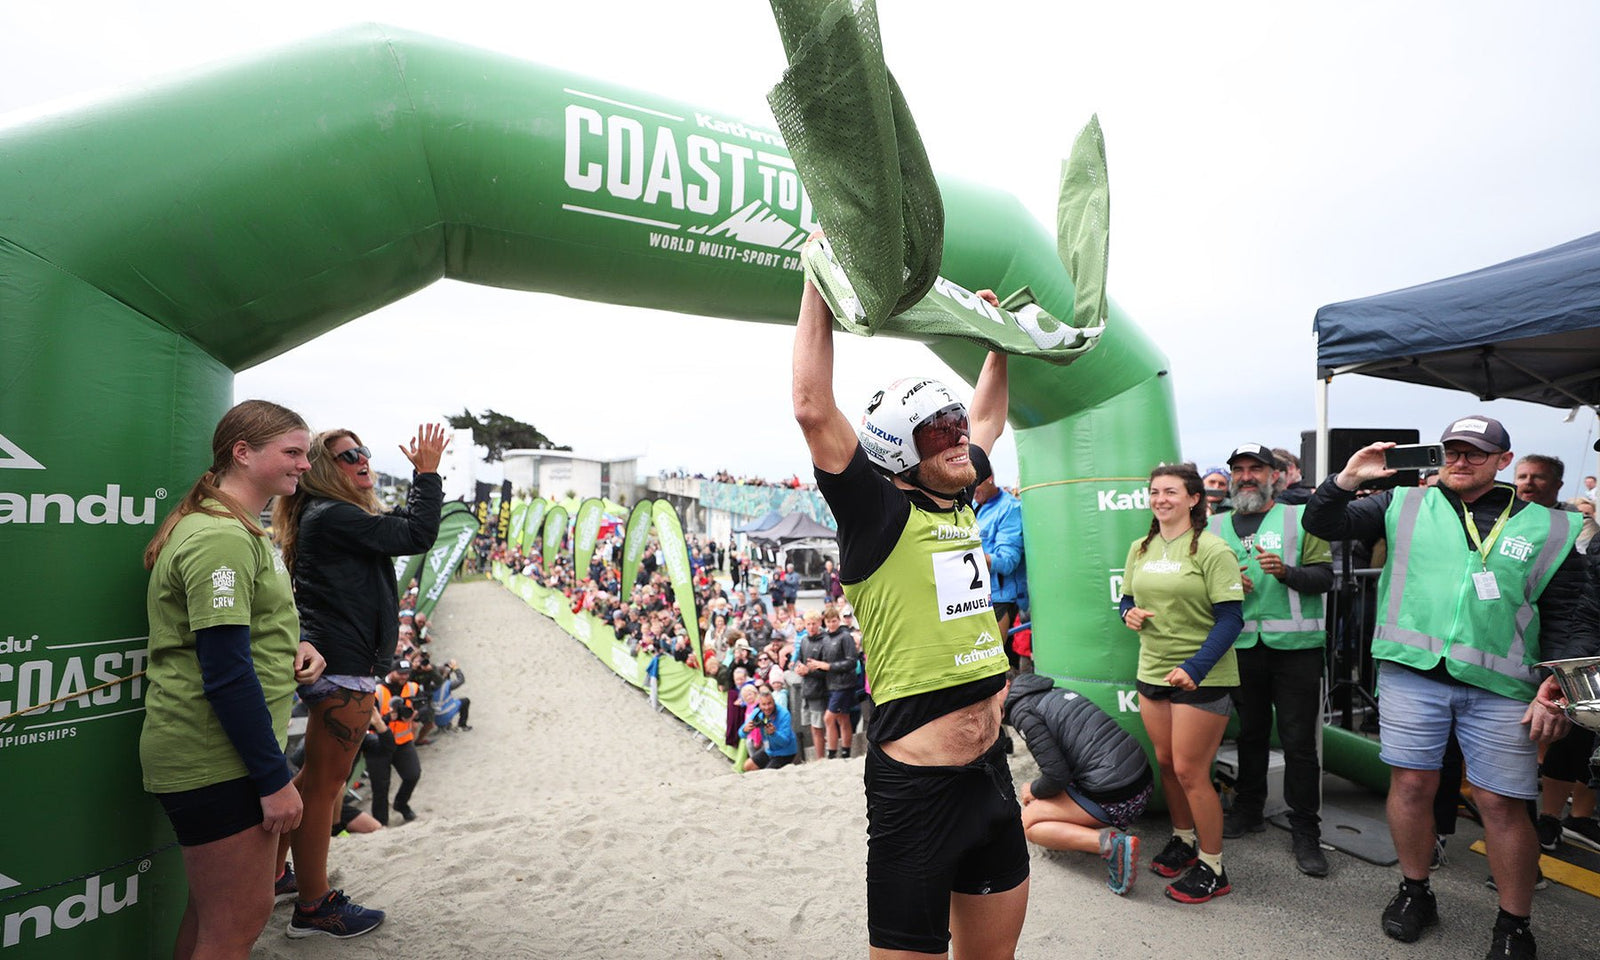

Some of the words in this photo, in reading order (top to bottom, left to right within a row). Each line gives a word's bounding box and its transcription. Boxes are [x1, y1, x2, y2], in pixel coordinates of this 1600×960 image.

[564, 104, 753, 215] COAST
[758, 165, 798, 210] TO
[650, 232, 694, 253] WORLD
[699, 241, 781, 267] MULTI-SPORT
[866, 421, 903, 447] SUZUKI
[897, 457, 909, 468] 2
[963, 553, 983, 590] 2
[213, 597, 235, 608] CREW
[946, 598, 987, 615] SAMUEL
[3, 873, 138, 947] ndu
